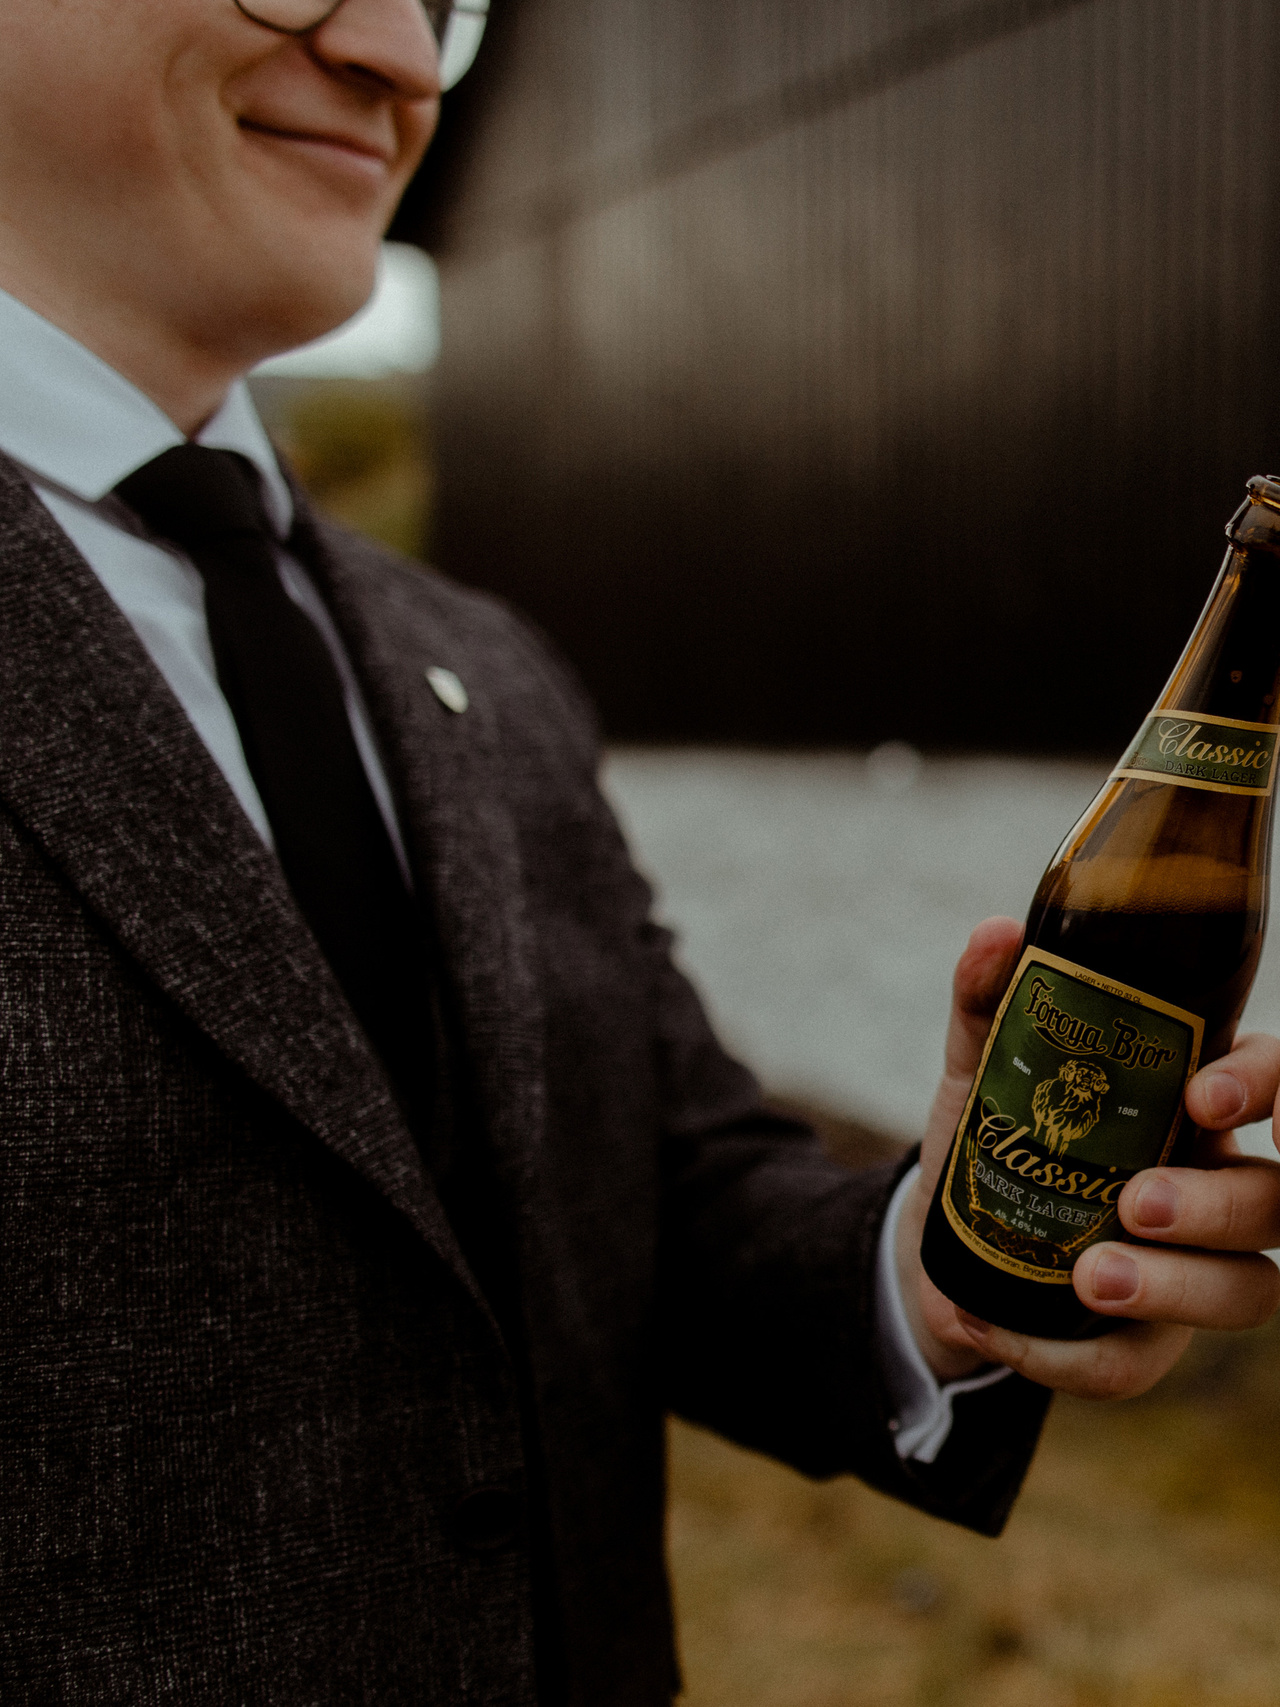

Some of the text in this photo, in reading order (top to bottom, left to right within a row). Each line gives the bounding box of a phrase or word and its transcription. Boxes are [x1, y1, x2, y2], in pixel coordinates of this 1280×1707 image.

[1158, 719, 1271, 769] Classic
[1164, 760, 1256, 784] DARK LAGER
[1074, 971, 1096, 985] LAGER
[1101, 982, 1124, 997] NETTO
[1106, 1017, 1178, 1071] Bjór
[1117, 1105, 1139, 1118] 1888
[977, 1096, 1128, 1204] Classic
[974, 1159, 1027, 1205] DARK
[1027, 1193, 1102, 1229] LAGER
[1010, 1217, 1032, 1233] 4.6%
